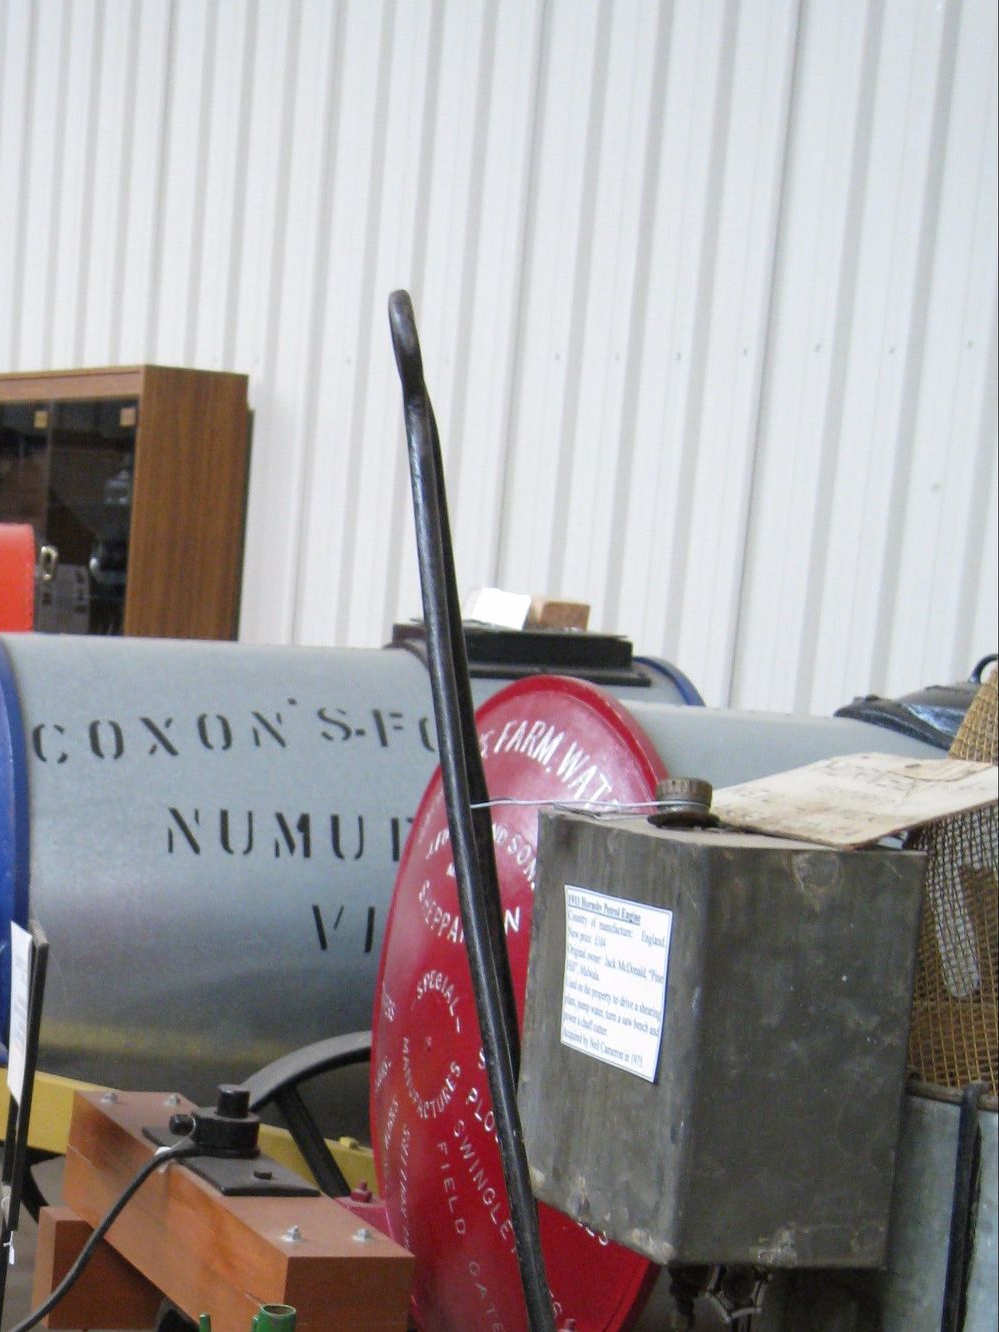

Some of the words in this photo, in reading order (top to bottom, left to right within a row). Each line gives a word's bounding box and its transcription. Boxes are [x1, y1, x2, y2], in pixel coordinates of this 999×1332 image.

[557, 741, 615, 809] WAT
[312, 905, 376, 953] VI
[622, 907, 641, 923] Engine
